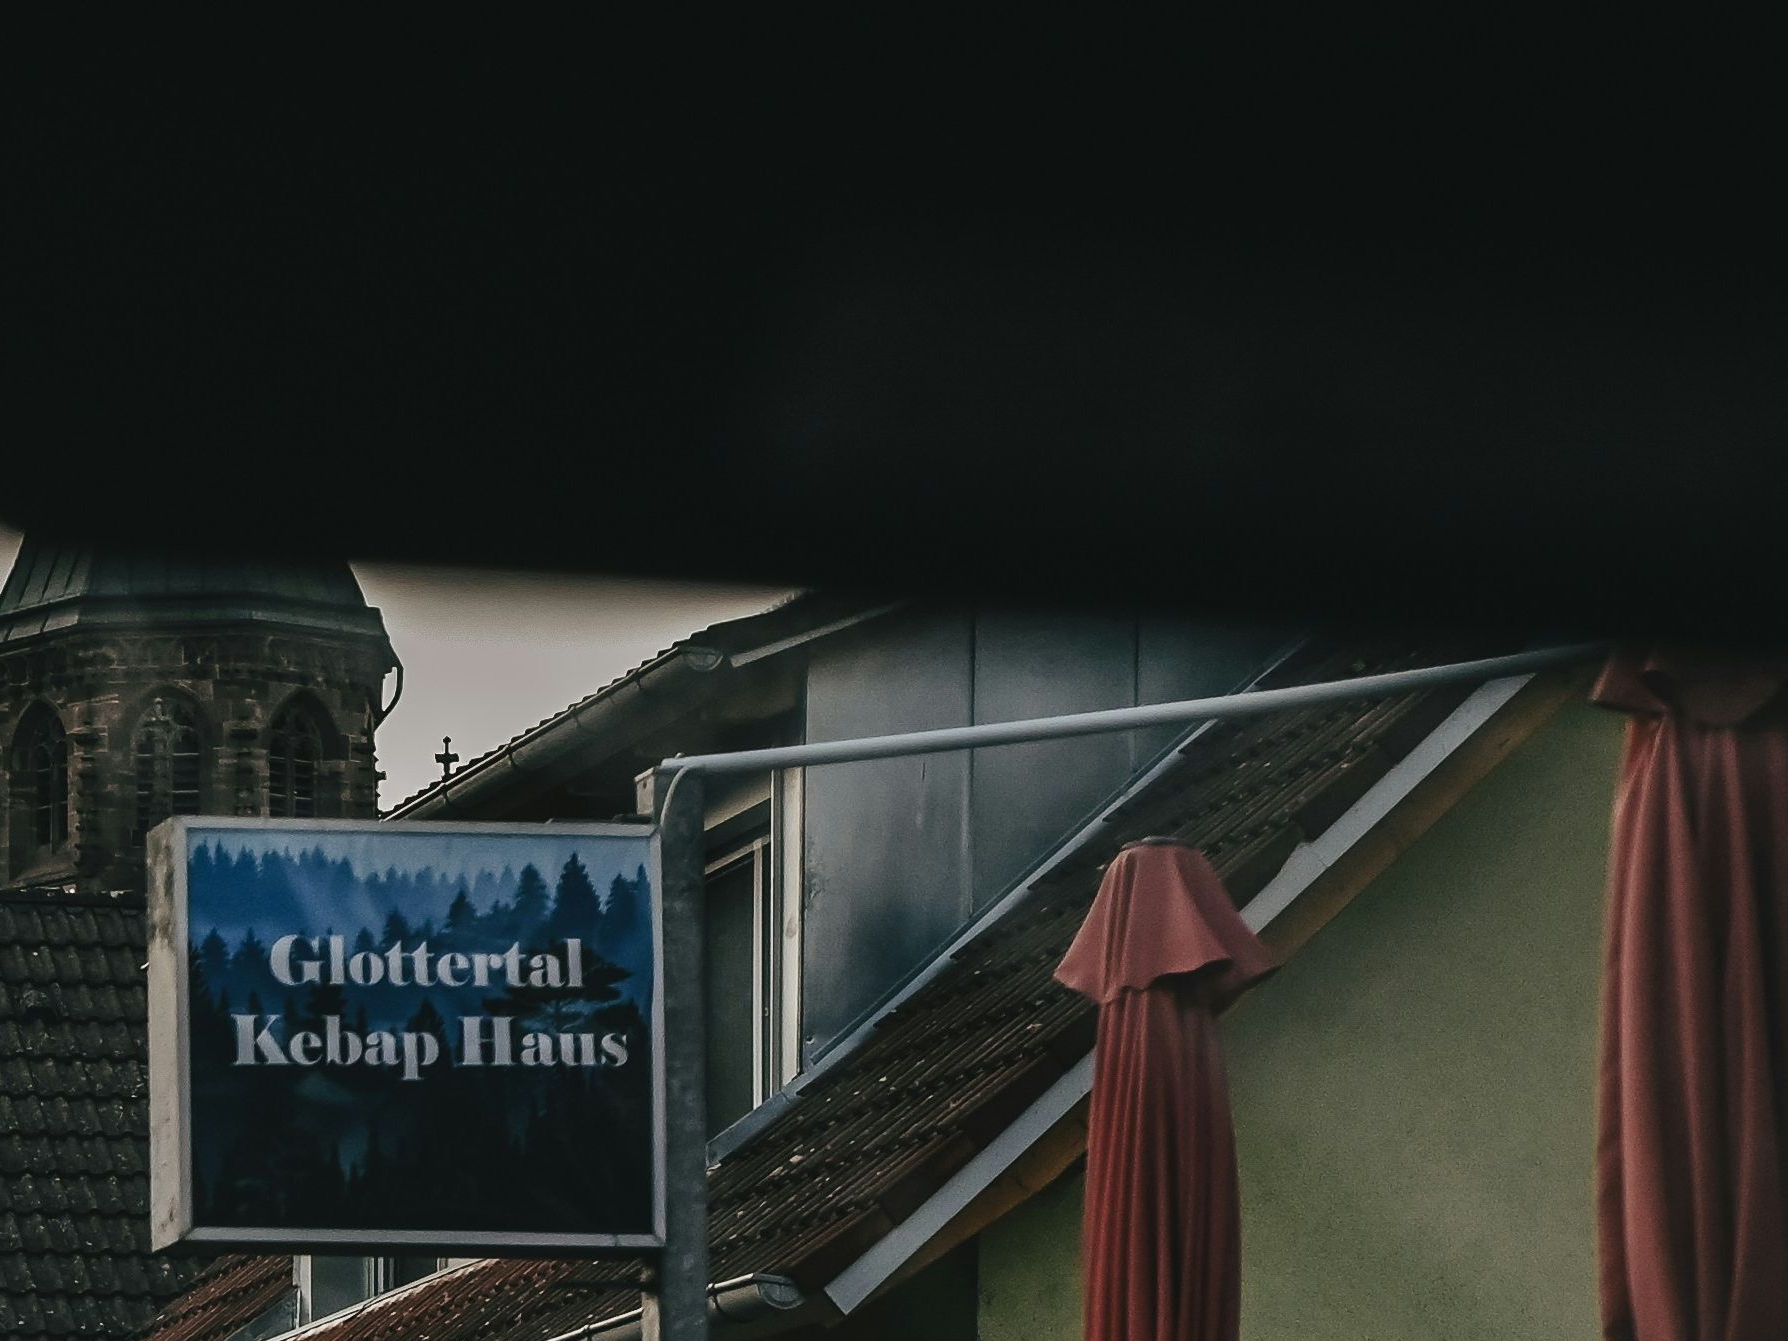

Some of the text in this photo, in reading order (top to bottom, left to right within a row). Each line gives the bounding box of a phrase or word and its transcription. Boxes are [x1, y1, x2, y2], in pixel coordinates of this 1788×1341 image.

[269, 934, 583, 987] Glottertal
[229, 1014, 628, 1080] Kebap Haus
